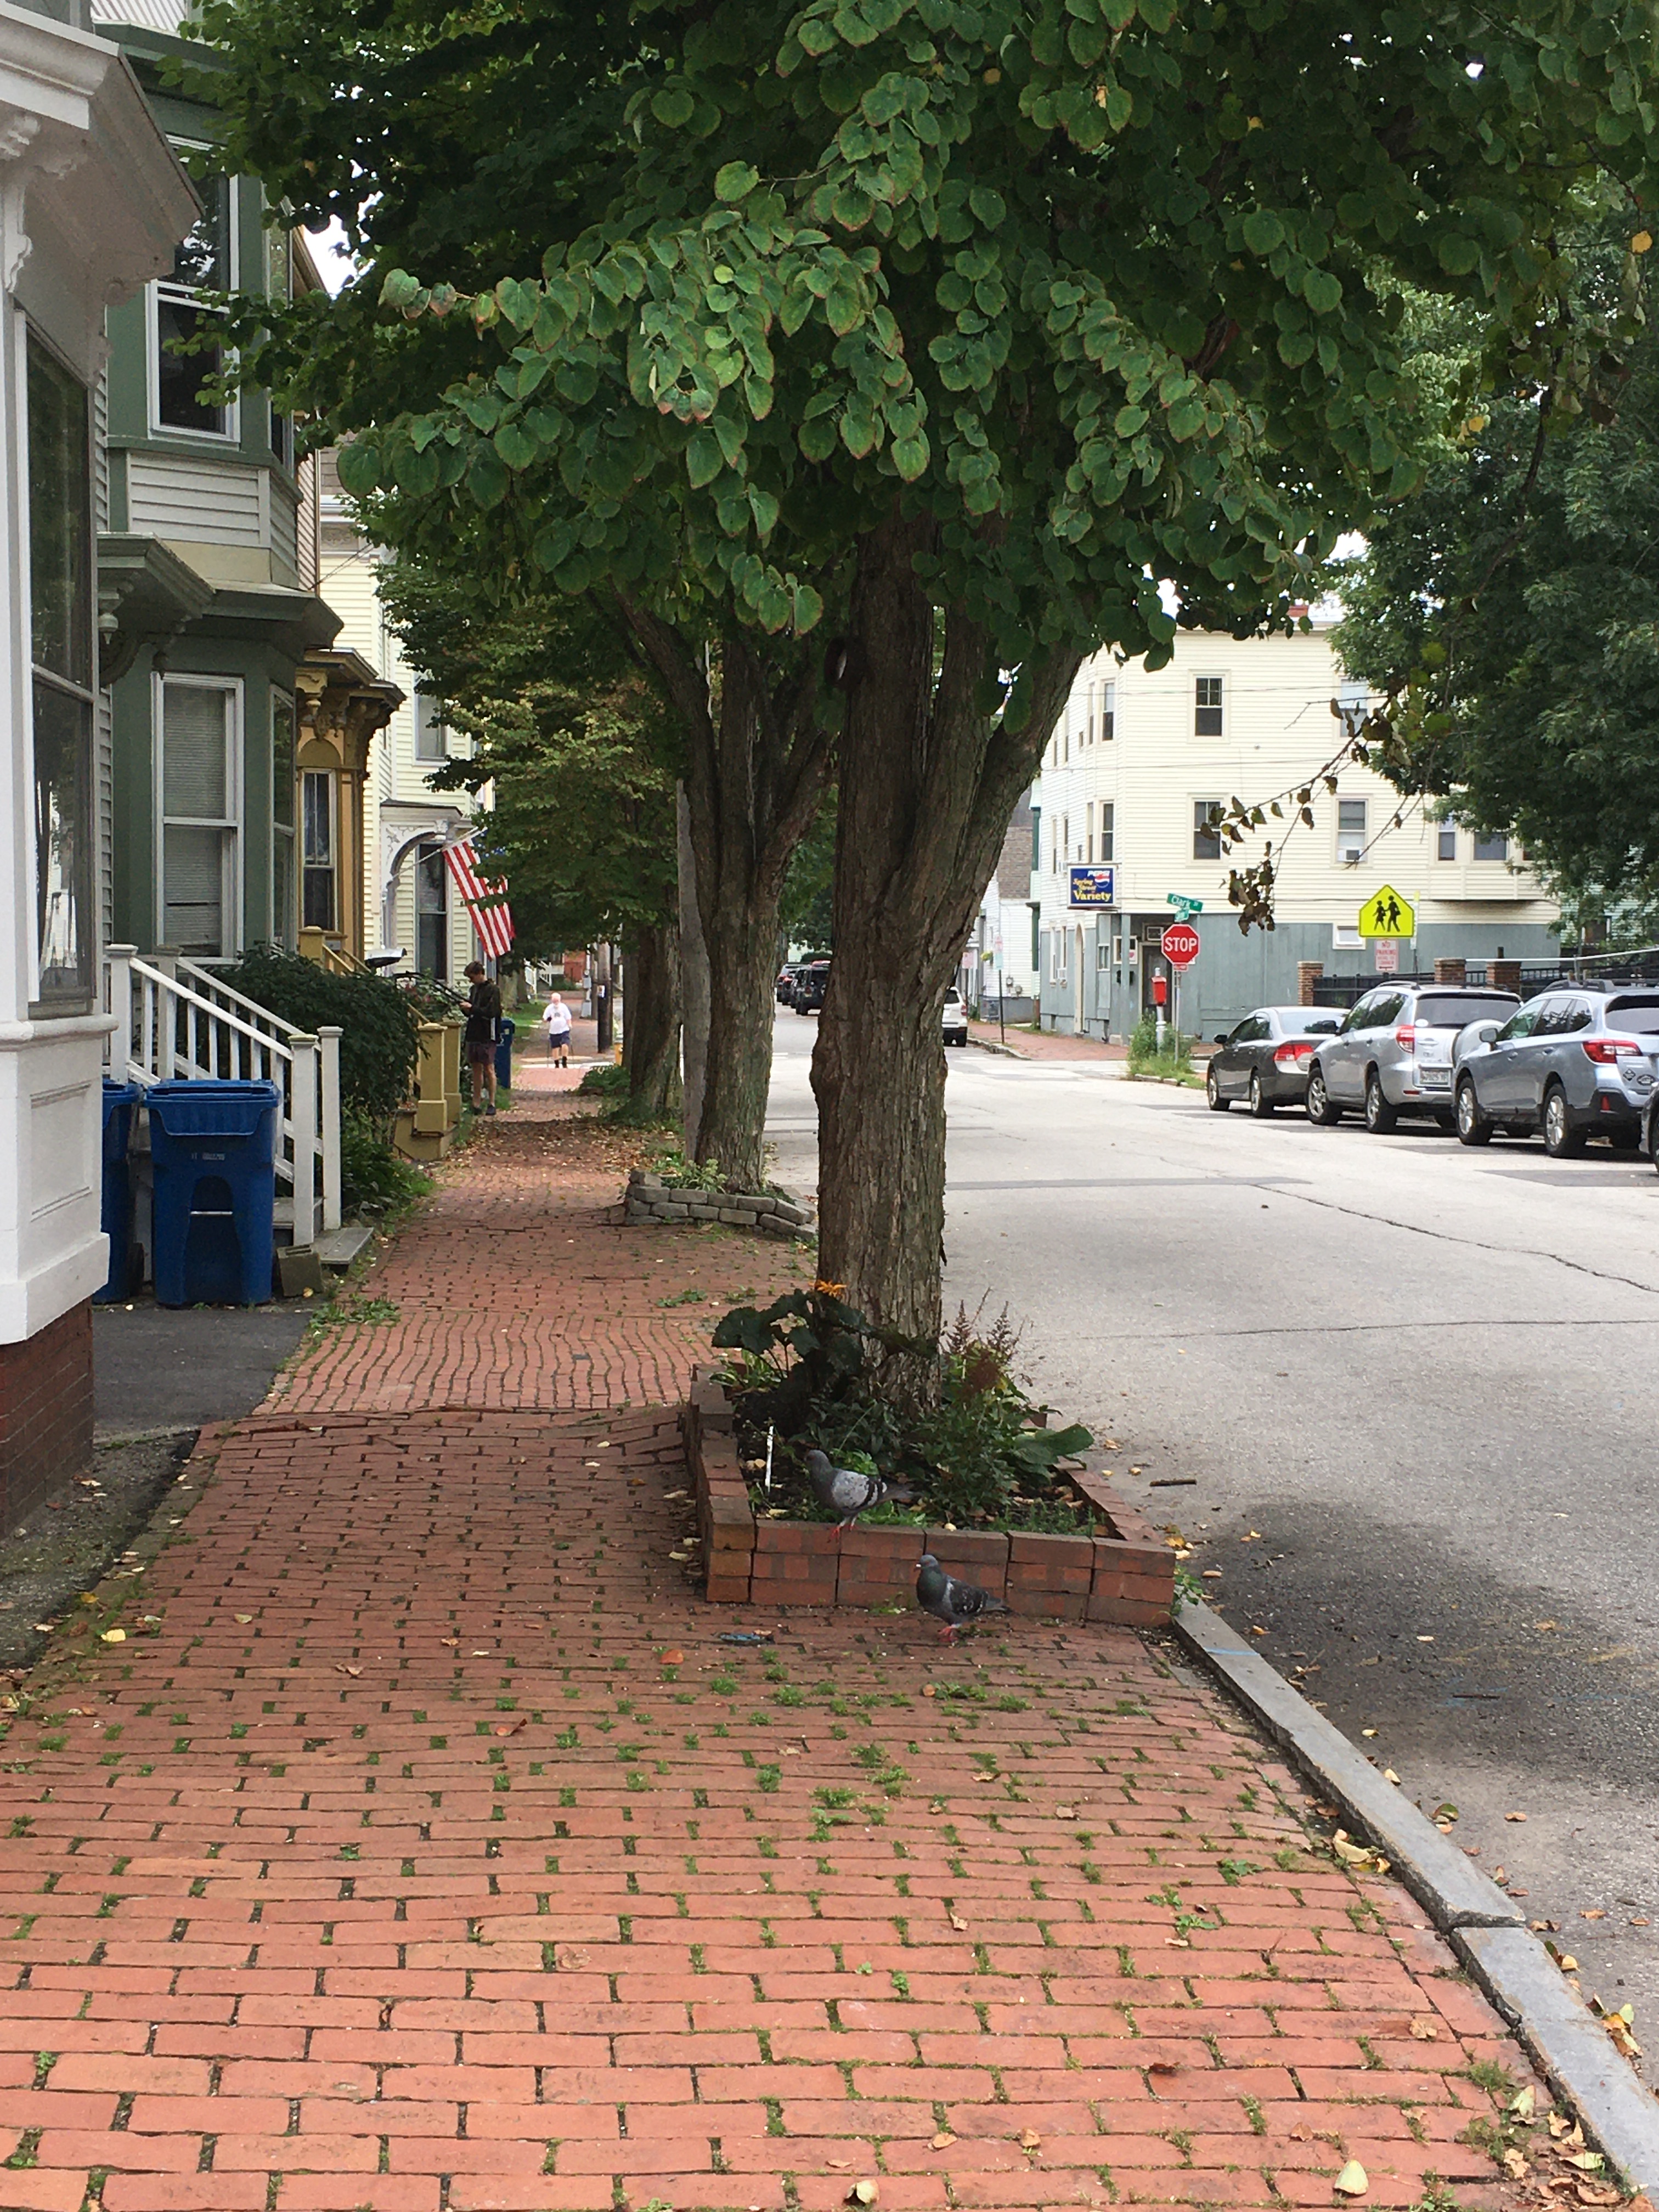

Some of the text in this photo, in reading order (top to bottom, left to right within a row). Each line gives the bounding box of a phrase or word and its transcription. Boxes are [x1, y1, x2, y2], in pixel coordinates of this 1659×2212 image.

[1073, 890, 1111, 902] Variety
[1171, 895, 1190, 907] Clark
[1164, 936, 1197, 952] STOP
